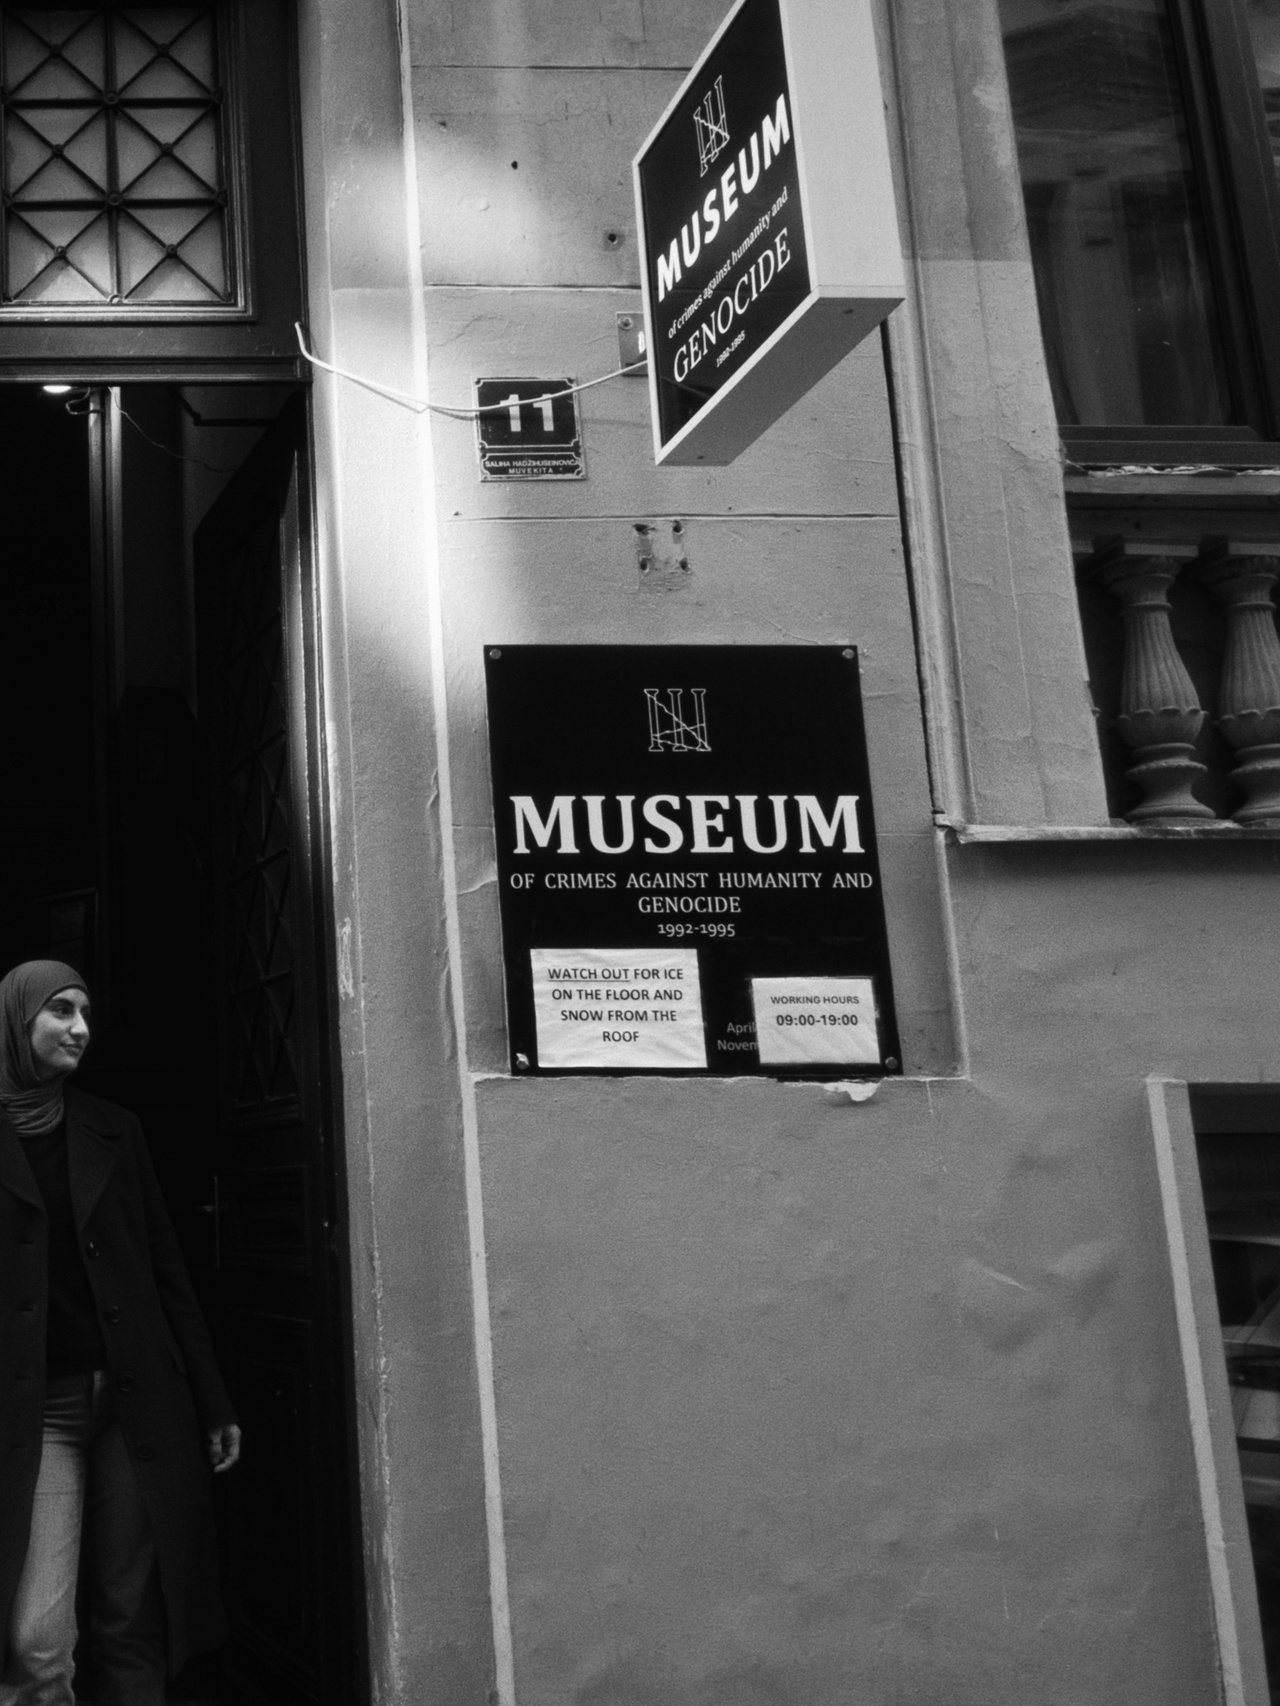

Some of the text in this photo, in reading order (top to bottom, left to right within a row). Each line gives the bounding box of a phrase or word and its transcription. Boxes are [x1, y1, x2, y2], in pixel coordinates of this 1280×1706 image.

[656, 93, 791, 303] MUSEUM
[668, 186, 788, 339] of crimes against humanity and
[673, 227, 792, 383] GENOCIDE
[500, 393, 554, 432] 11
[485, 460, 510, 468] SALIHA
[508, 467, 554, 475] MUVEKITA
[509, 794, 866, 854] MUSEUM
[509, 872, 873, 890] OF CRIMES AGAINST HUMANITY AND
[638, 896, 742, 914] GENOCIDE
[656, 922, 736, 938] 1992-1995
[547, 967, 684, 980] WATCH OUT FOR ICE
[552, 988, 683, 1001] ON THE FLOOR AND
[770, 996, 860, 1005] WORKING HOURS
[560, 1009, 677, 1022] SNOW FROM THE
[776, 1014, 859, 1027] 09:00-19:00
[726, 1021, 756, 1036] April
[602, 1030, 640, 1043] ROOF
